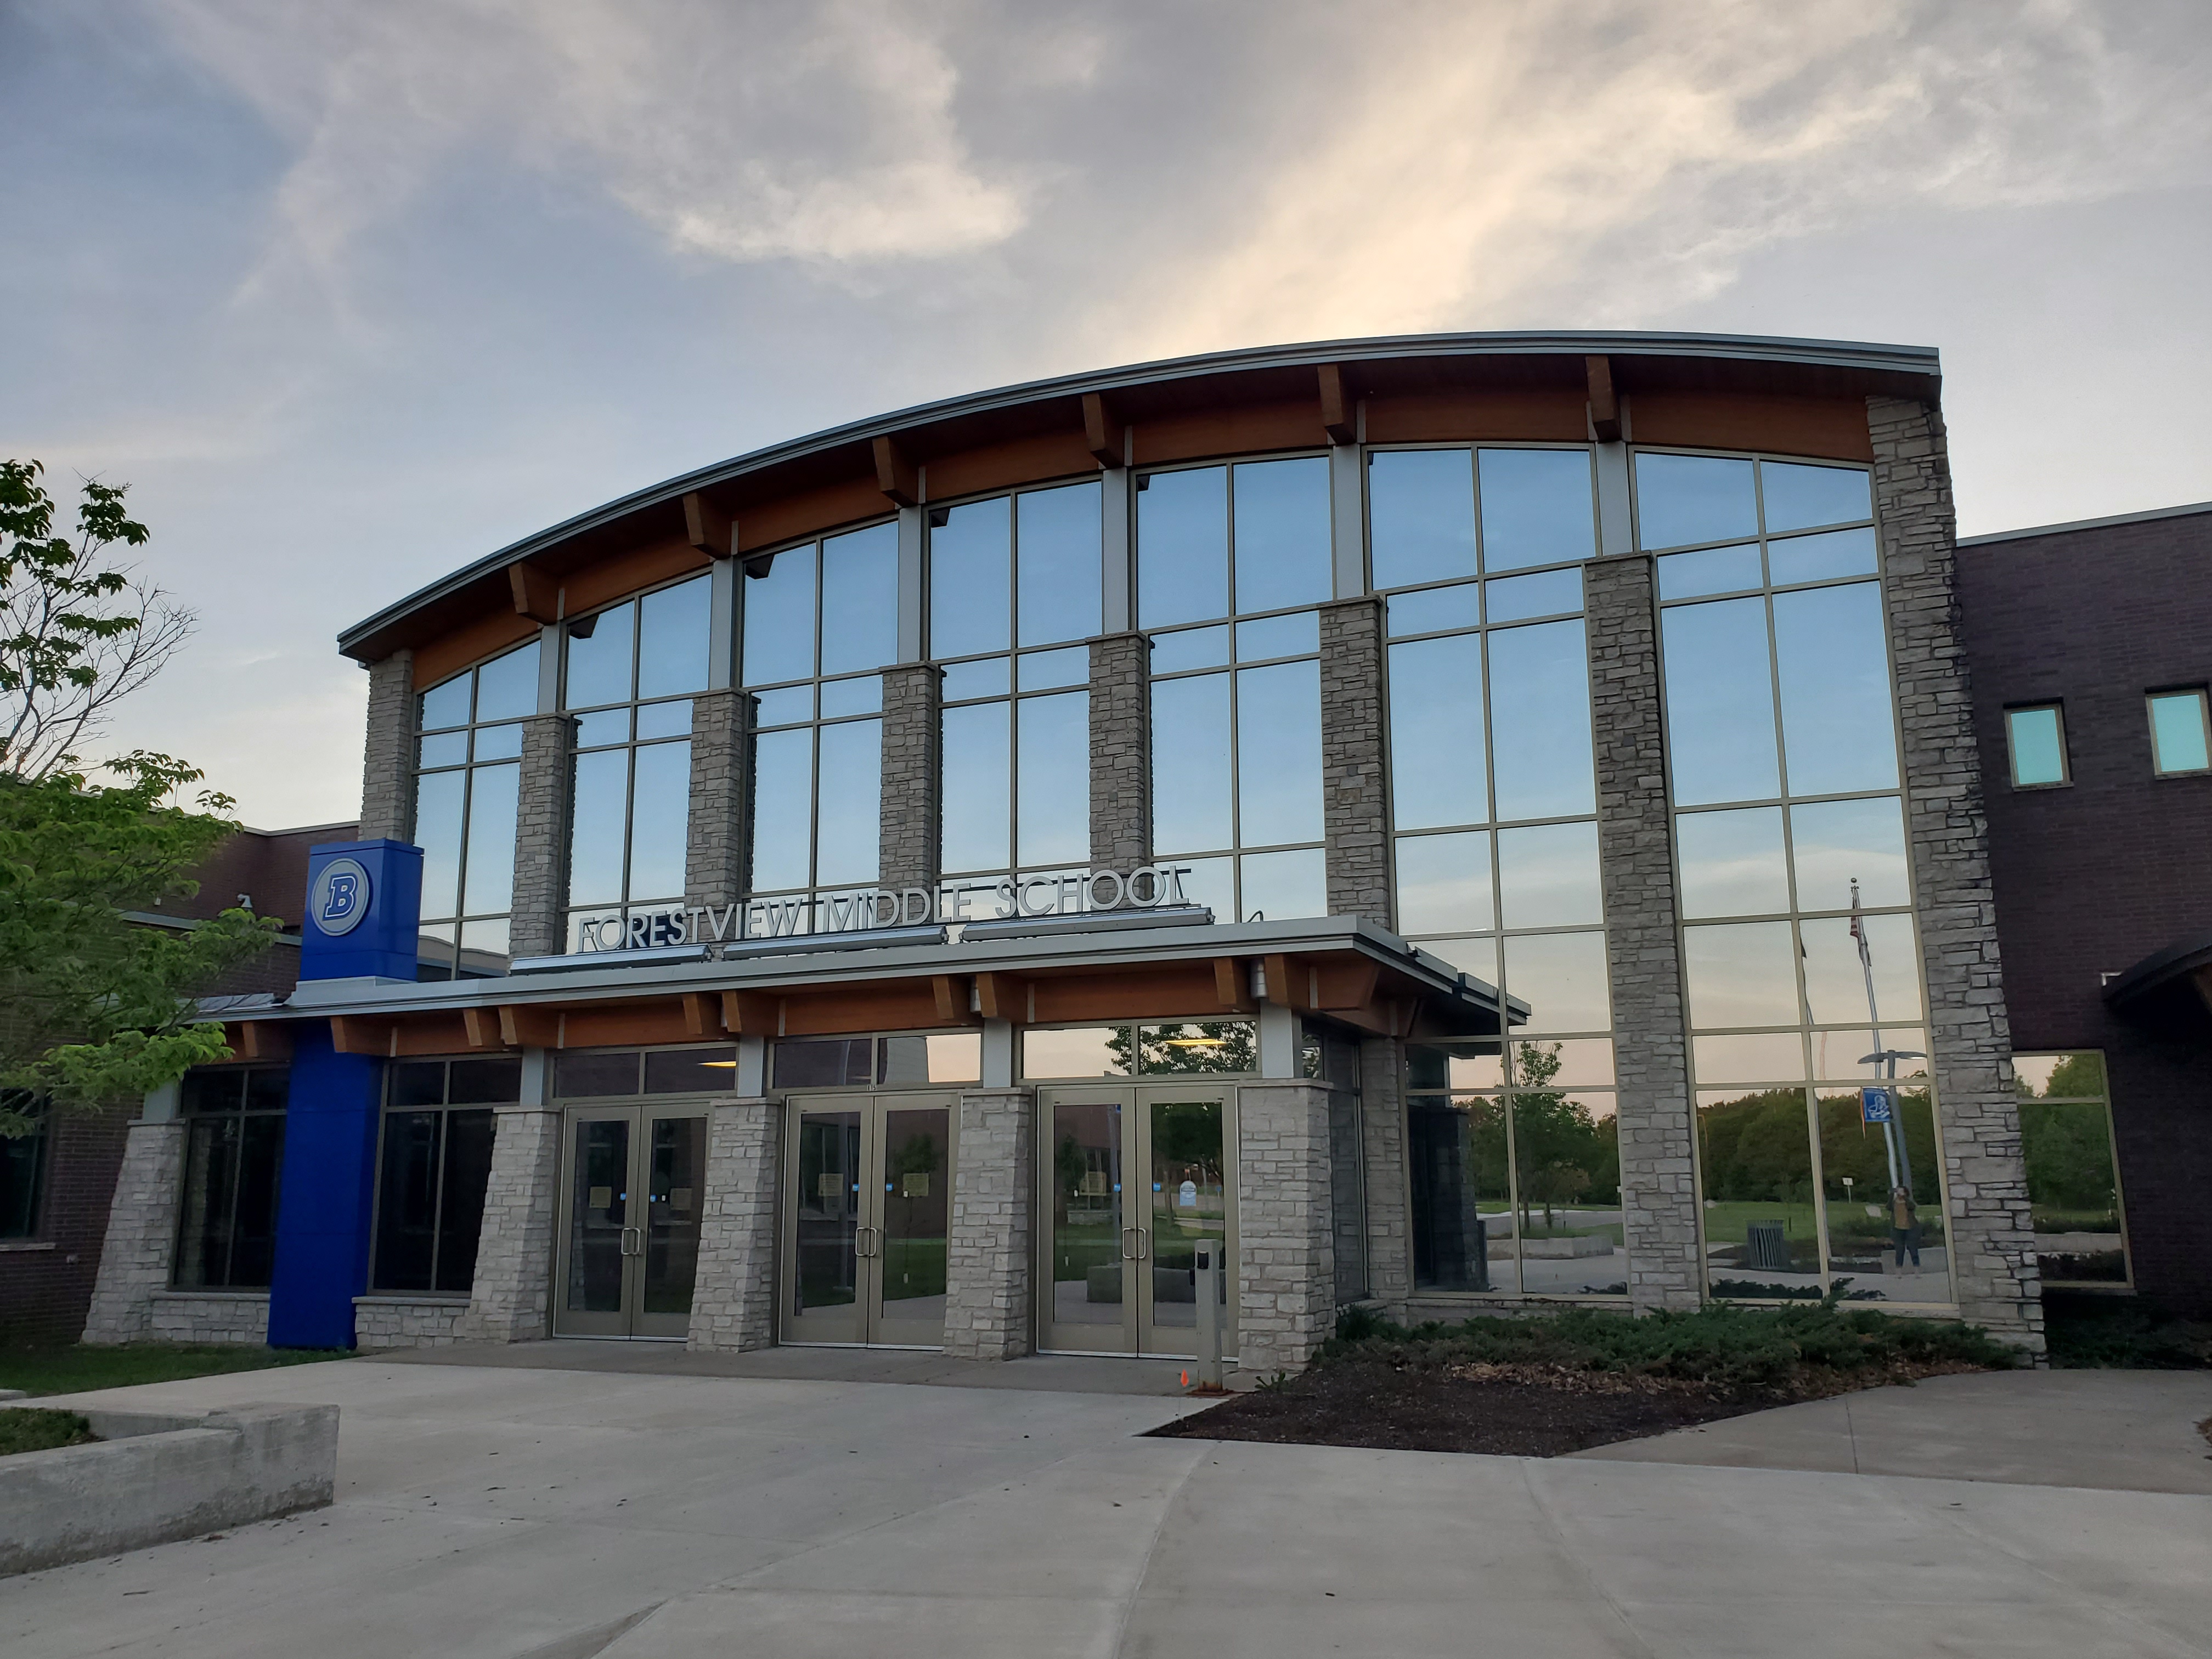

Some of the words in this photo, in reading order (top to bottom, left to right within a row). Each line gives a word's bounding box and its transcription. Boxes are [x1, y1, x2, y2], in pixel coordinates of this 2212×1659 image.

[323, 873, 358, 921] B
[578, 898, 803, 952] FORESTVIEW
[823, 882, 972, 932] MIDDLE
[995, 865, 1189, 918] SCHOOL
